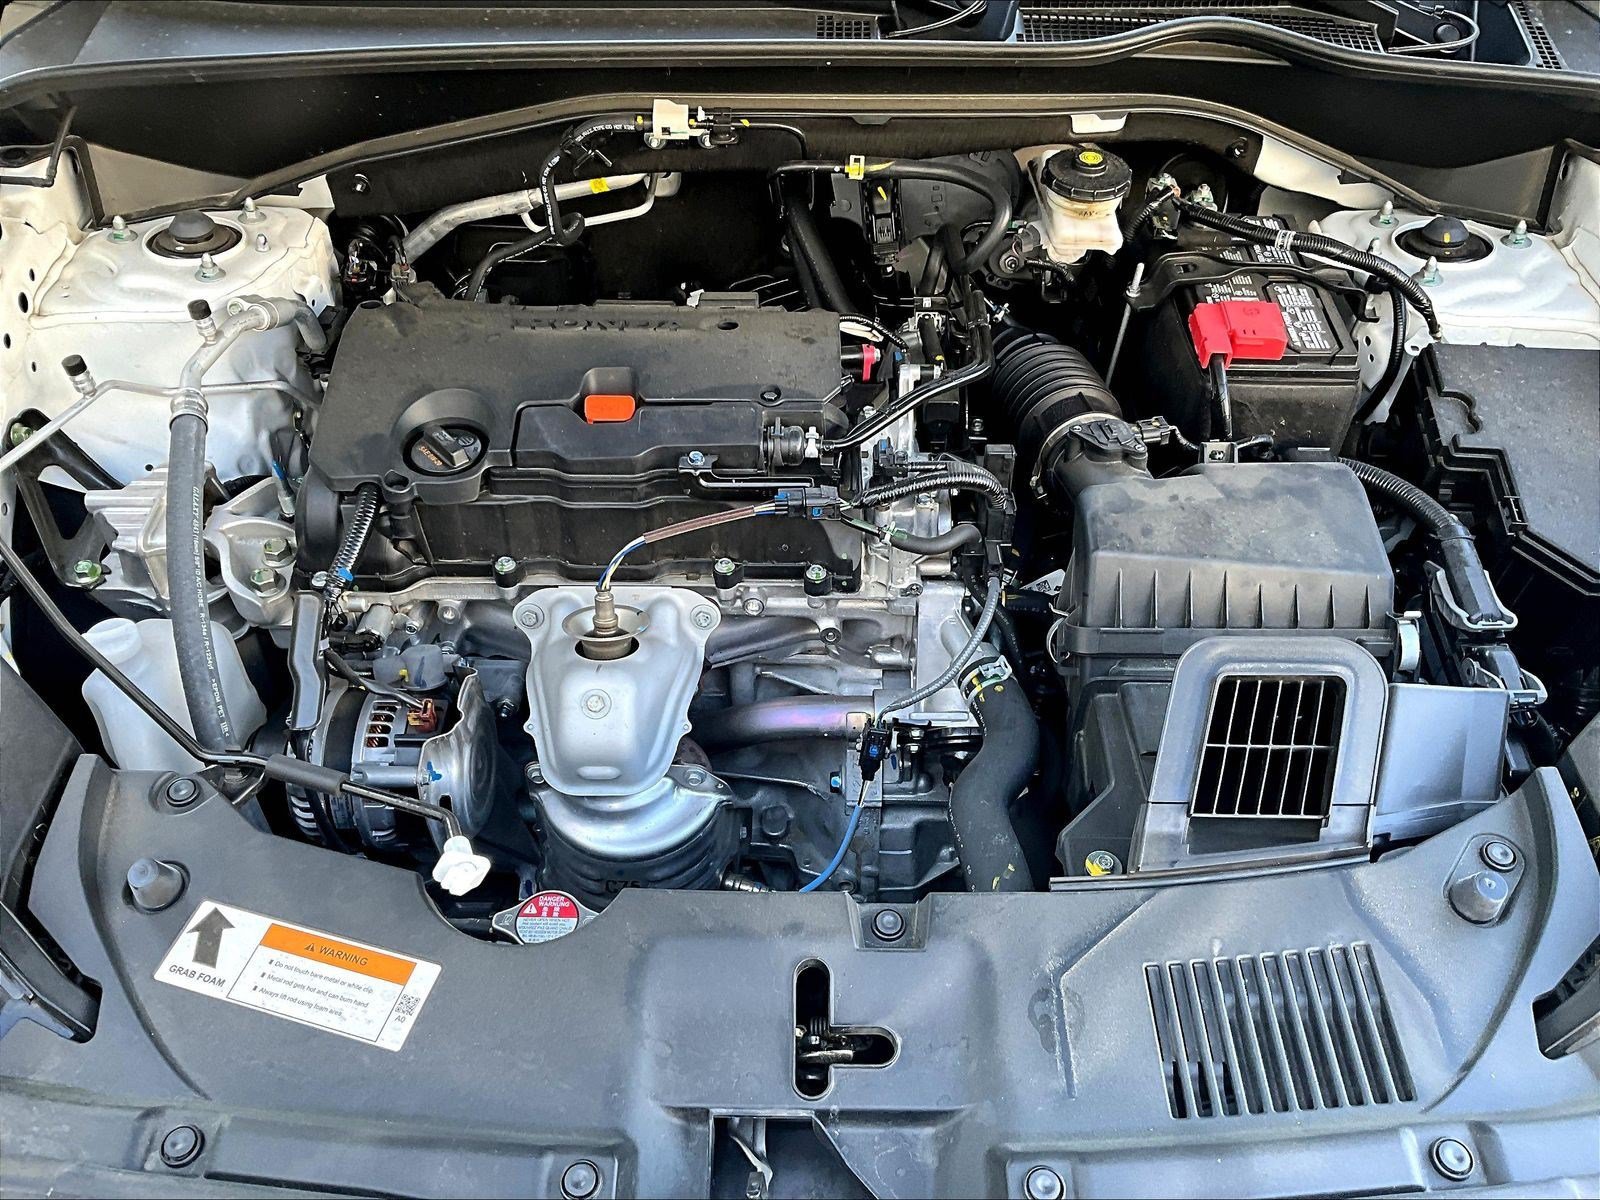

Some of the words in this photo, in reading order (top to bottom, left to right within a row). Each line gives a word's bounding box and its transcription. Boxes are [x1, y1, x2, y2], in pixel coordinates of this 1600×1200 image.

[320, 946, 368, 966] WARNING
[168, 964, 197, 979] GRAB
[197, 972, 226, 988] FOAM
[284, 964, 294, 972] not
[294, 966, 310, 975] touch
[310, 971, 324, 980] bare
[324, 975, 340, 984] metal
[347, 982, 364, 991] white
[363, 985, 374, 994] clip
[259, 987, 279, 998] Always
[287, 995, 298, 1003] rod
[298, 999, 314, 1009] using
[314, 1003, 329, 1012] foam
[267, 974, 283, 983] Metal
[283, 978, 294, 986] rod
[293, 980, 306, 991] gets
[306, 985, 316, 993] hot
[316, 988, 328, 997] and
[340, 995, 353, 1004] burn
[353, 998, 370, 1008] hand
